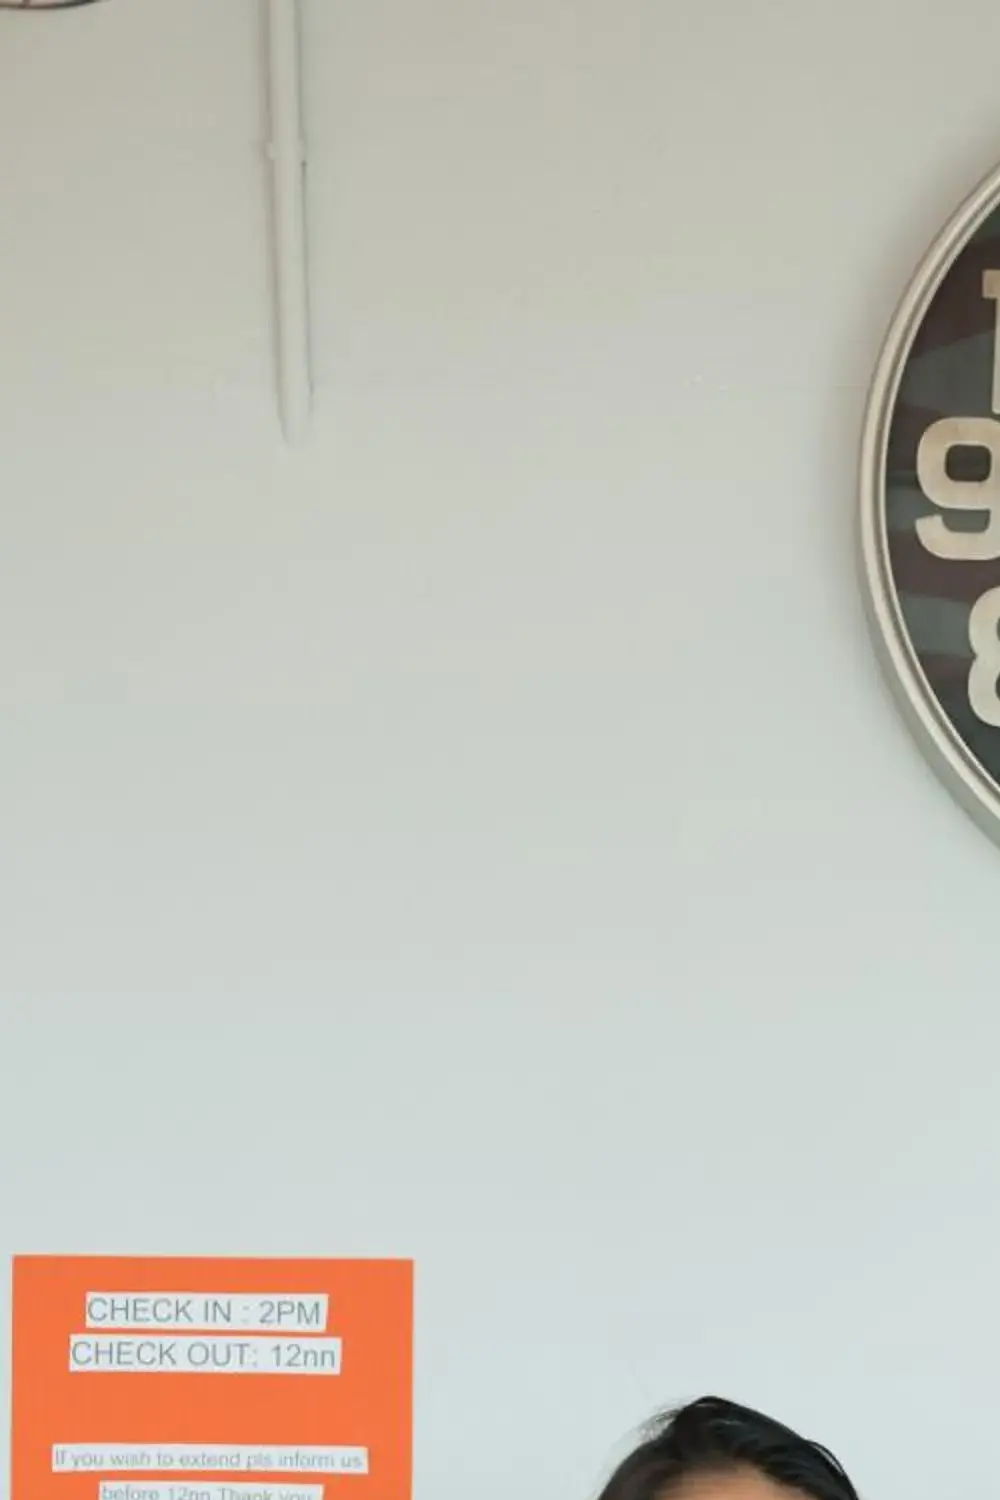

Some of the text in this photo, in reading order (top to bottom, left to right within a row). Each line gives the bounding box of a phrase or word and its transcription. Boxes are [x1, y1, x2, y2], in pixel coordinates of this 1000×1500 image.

[87, 1297, 194, 1323] CHECK
[203, 1299, 232, 1323] IN
[258, 1300, 321, 1325] 2PM
[71, 1340, 177, 1367] CHECK
[271, 1343, 336, 1369] 12nn
[54, 1450, 364, 1469] If you wish to extend pls inform us
